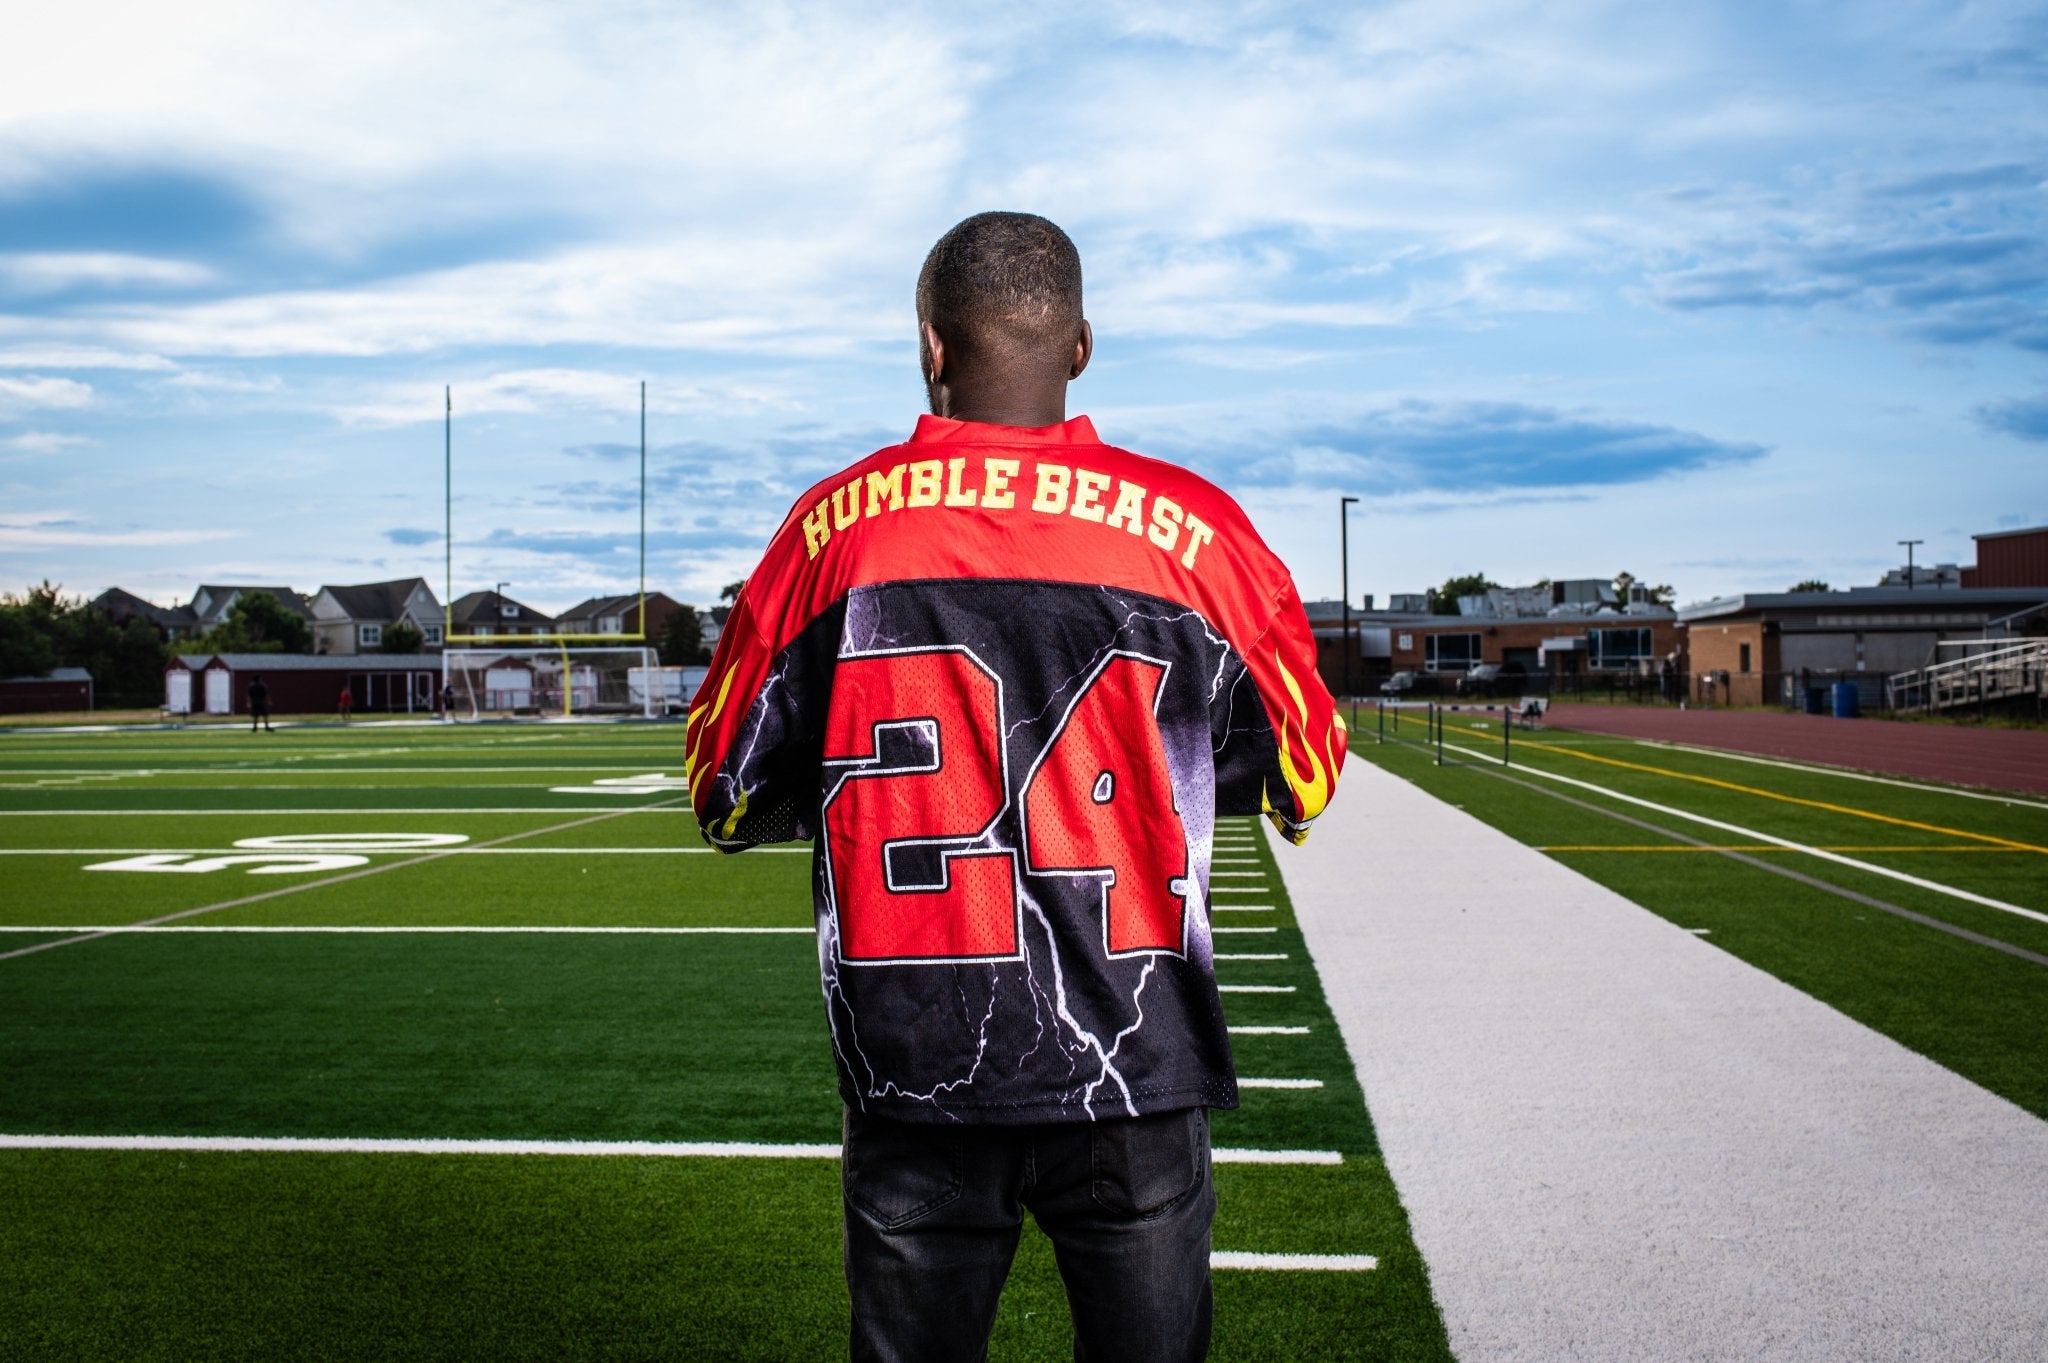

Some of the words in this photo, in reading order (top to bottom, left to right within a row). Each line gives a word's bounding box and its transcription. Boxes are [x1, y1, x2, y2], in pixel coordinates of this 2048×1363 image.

[802, 457, 1020, 560] HUMBLE
[1031, 462, 1214, 570] BEAST
[81, 832, 471, 874] 50
[822, 645, 1188, 966] 24
